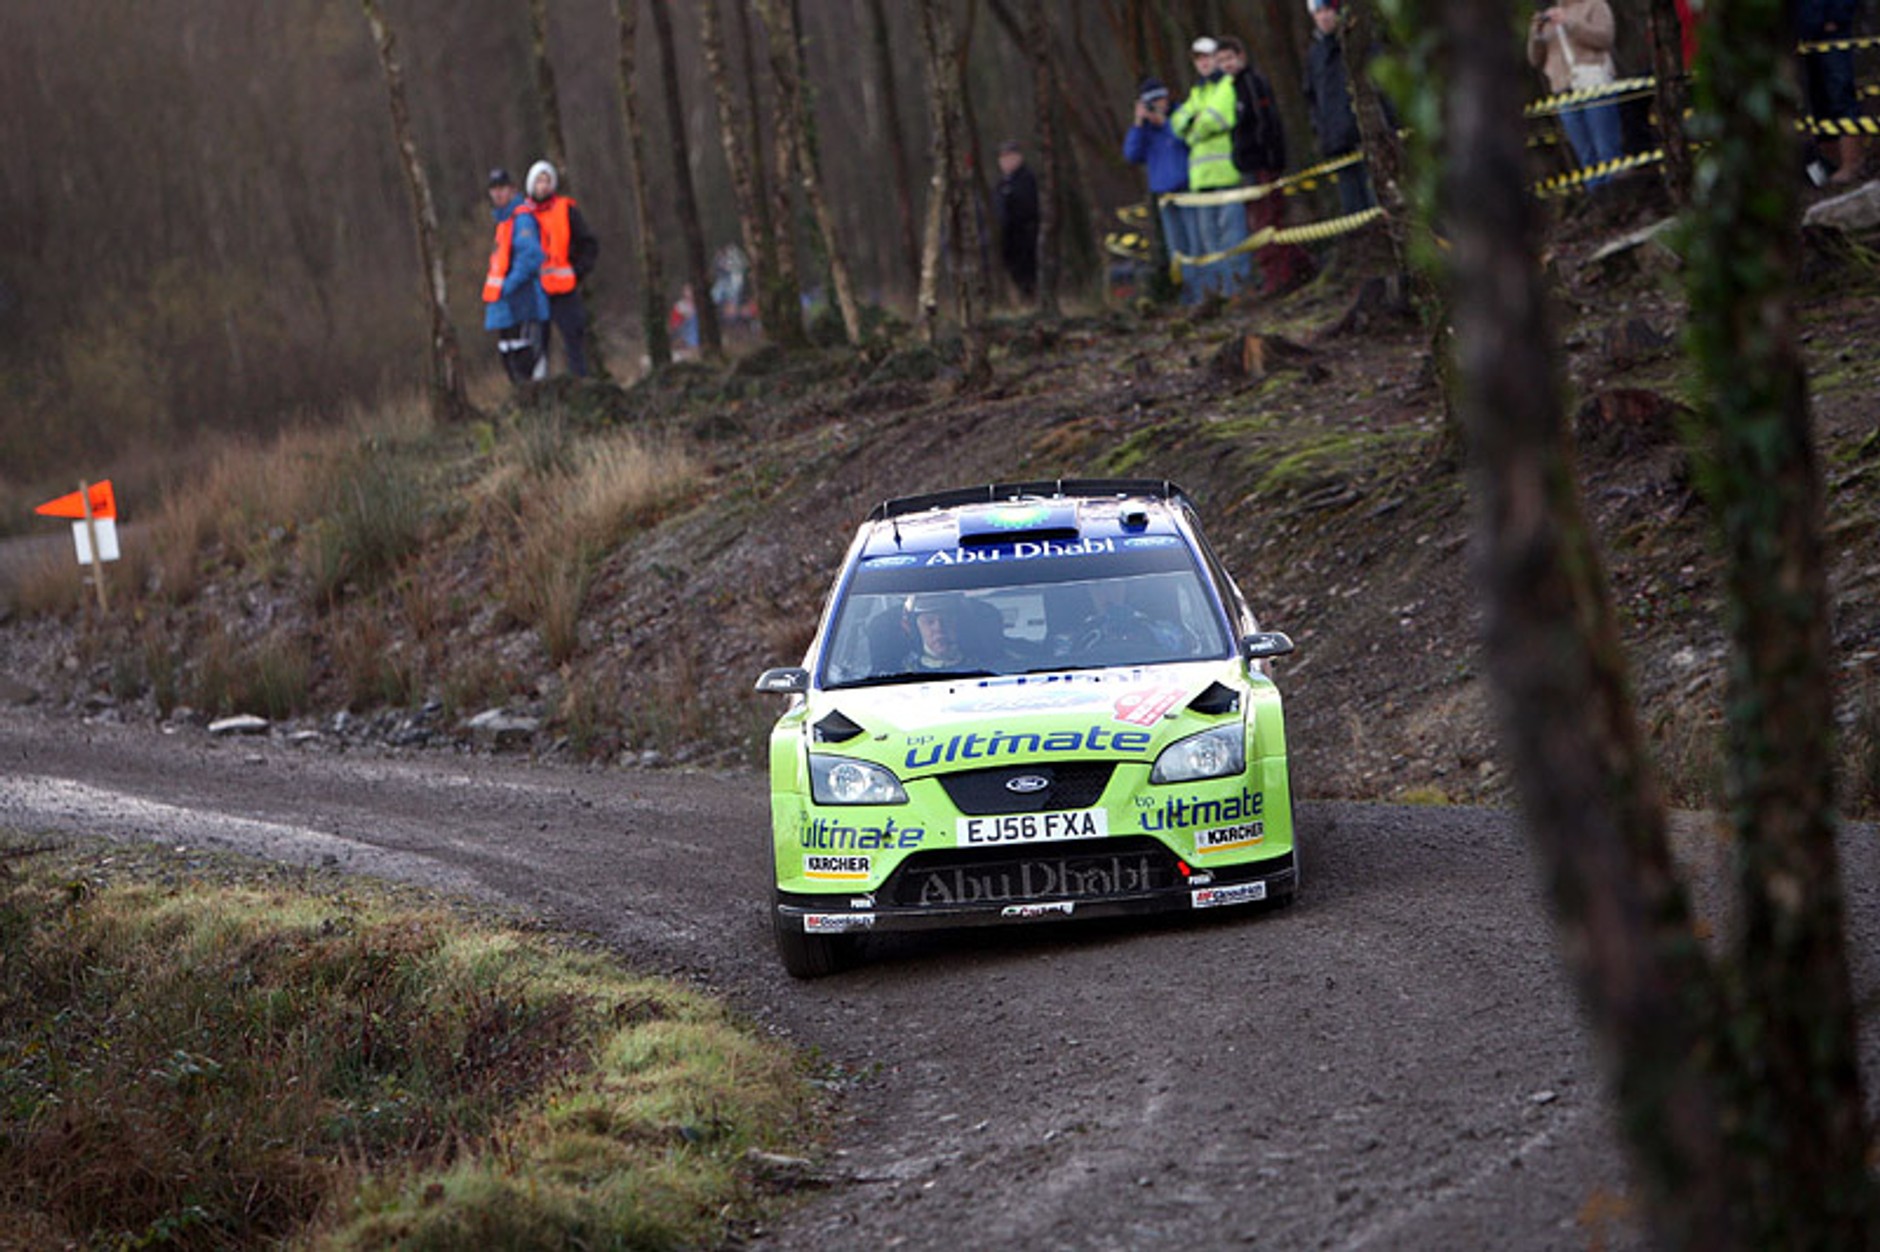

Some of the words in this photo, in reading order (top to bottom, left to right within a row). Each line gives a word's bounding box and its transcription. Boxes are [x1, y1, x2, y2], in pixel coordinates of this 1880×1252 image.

[926, 548, 999, 566] Abu
[904, 725, 1151, 769] ultimate
[1140, 786, 1263, 831] ultimate
[801, 816, 925, 849] ultimate
[967, 816, 1037, 843] EJ56
[1044, 812, 1097, 837] FXA
[919, 868, 1010, 905] Abu
